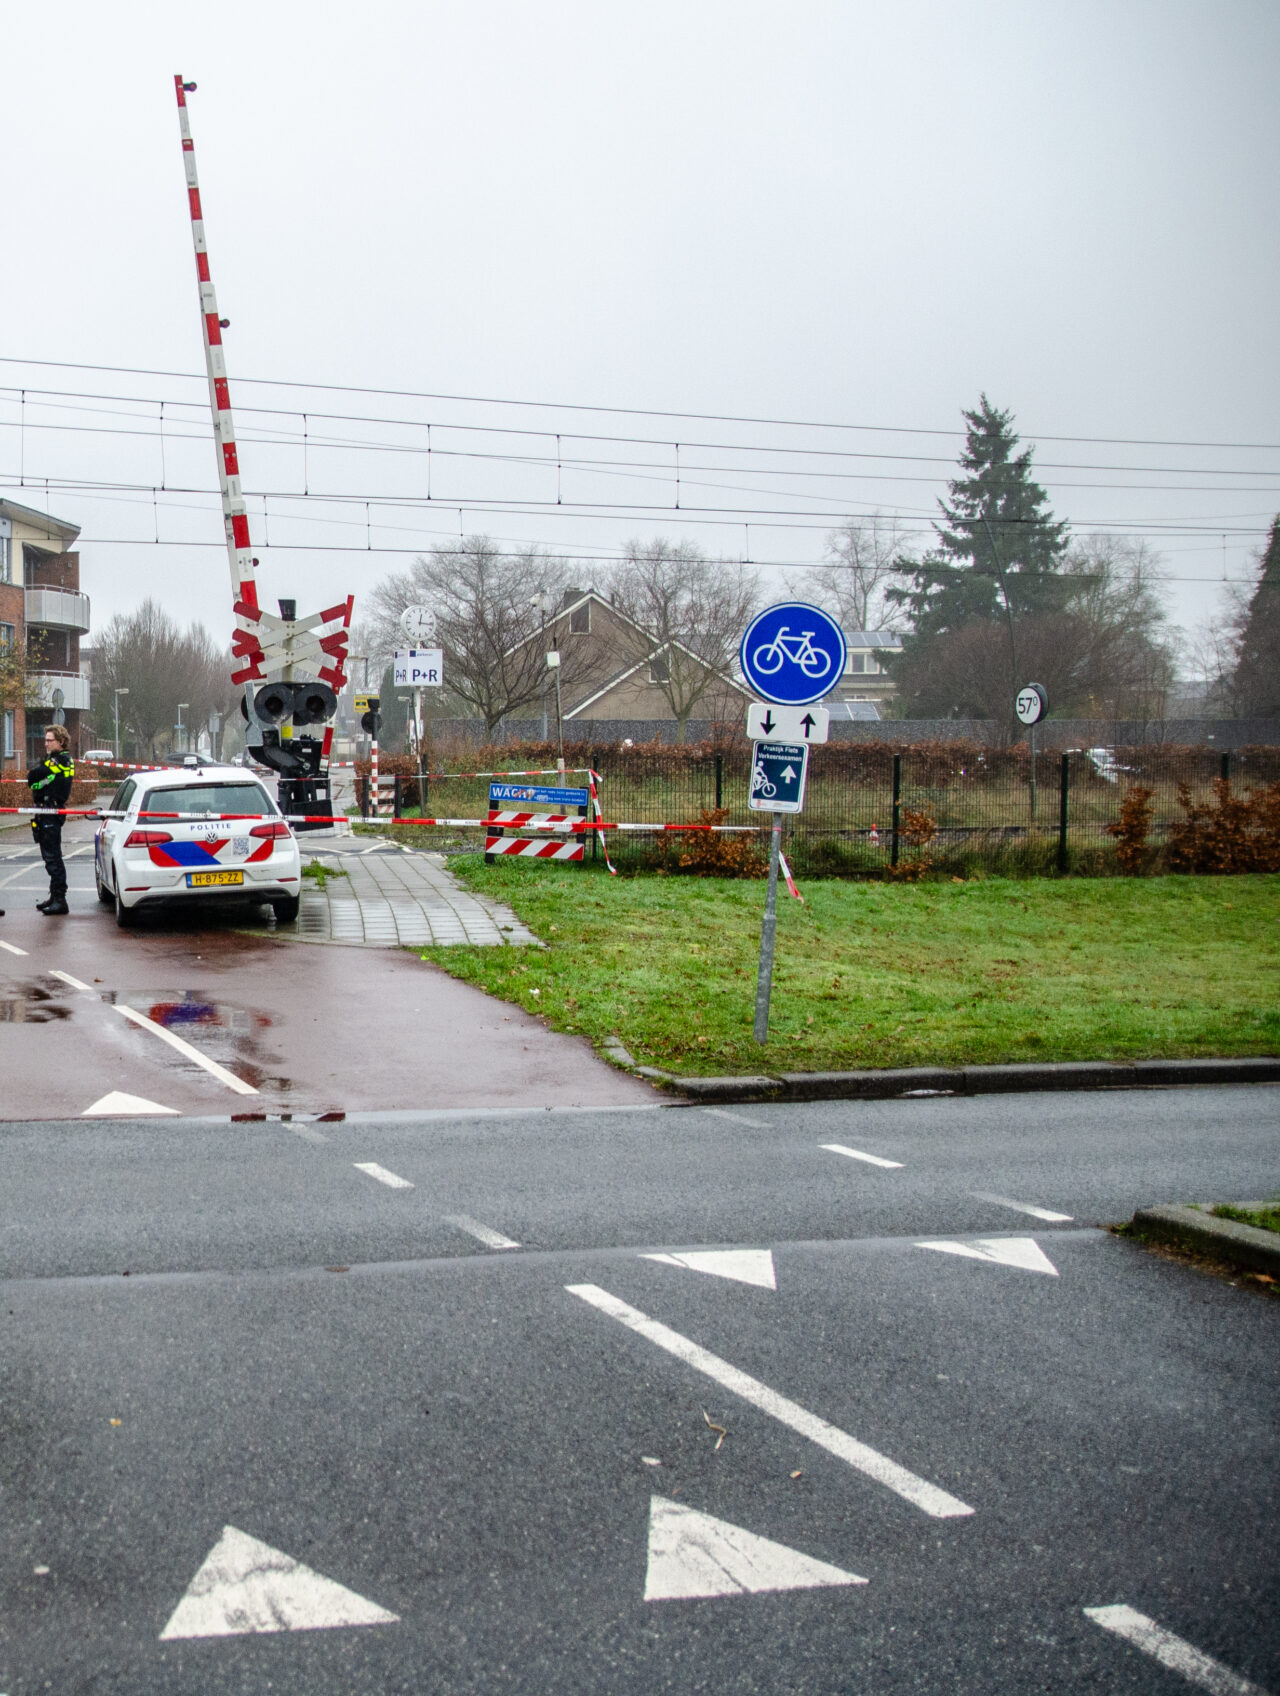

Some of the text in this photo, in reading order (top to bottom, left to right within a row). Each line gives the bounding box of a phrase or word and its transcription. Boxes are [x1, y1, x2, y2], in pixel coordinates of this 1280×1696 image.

[395, 669, 407, 683] P+R
[412, 669, 438, 682] P+R
[763, 744, 784, 753] Praktijk
[758, 752, 802, 762] Verkeersexamen
[190, 823, 231, 831] POLITIE
[195, 872, 239, 884] H-875-ZZ
